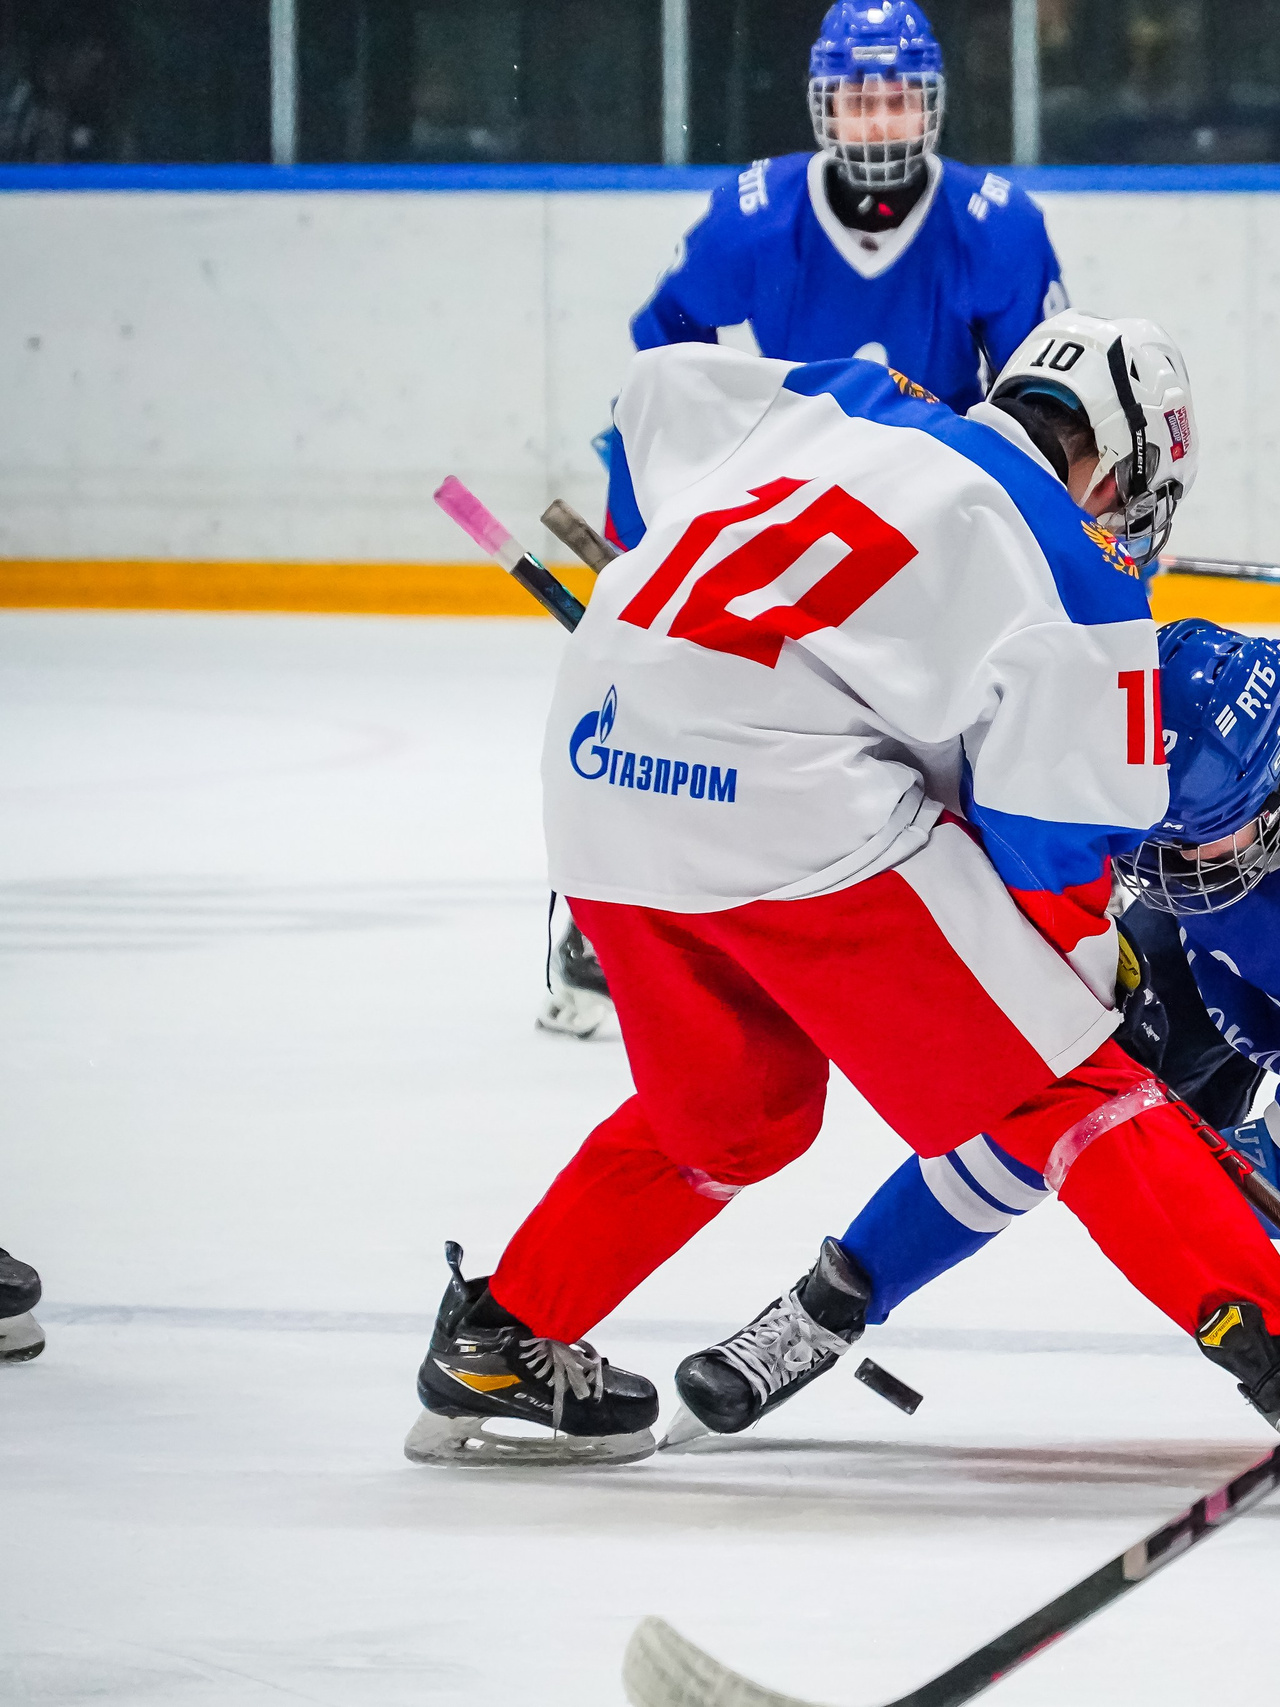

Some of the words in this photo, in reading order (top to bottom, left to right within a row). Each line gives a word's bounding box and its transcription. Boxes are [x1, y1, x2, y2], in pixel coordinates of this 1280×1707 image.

[1030, 338, 1085, 372] 10
[617, 476, 919, 670] 10
[609, 749, 738, 804] ГАЗПРОМ
